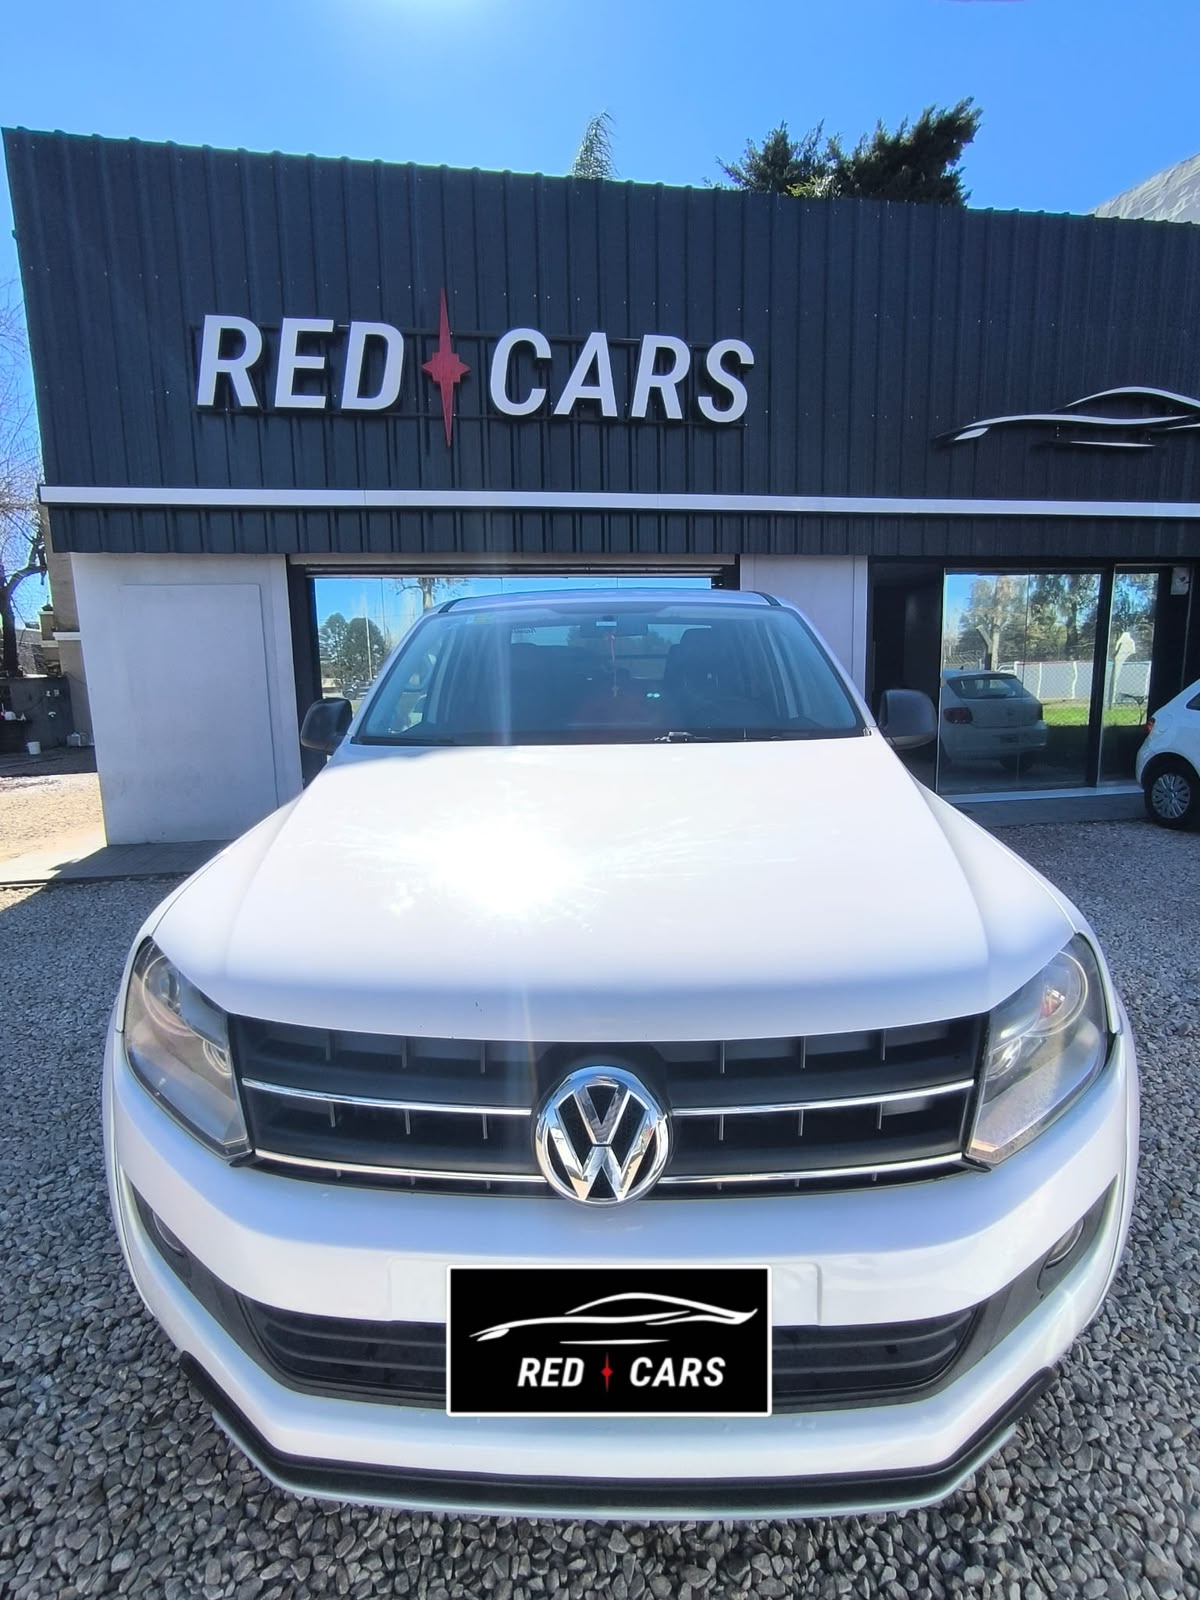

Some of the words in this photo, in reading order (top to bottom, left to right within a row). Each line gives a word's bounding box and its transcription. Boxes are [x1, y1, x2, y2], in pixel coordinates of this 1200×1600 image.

[196, 314, 404, 411] RED
[490, 328, 754, 423] CARS
[544, 1077, 661, 1203] VW
